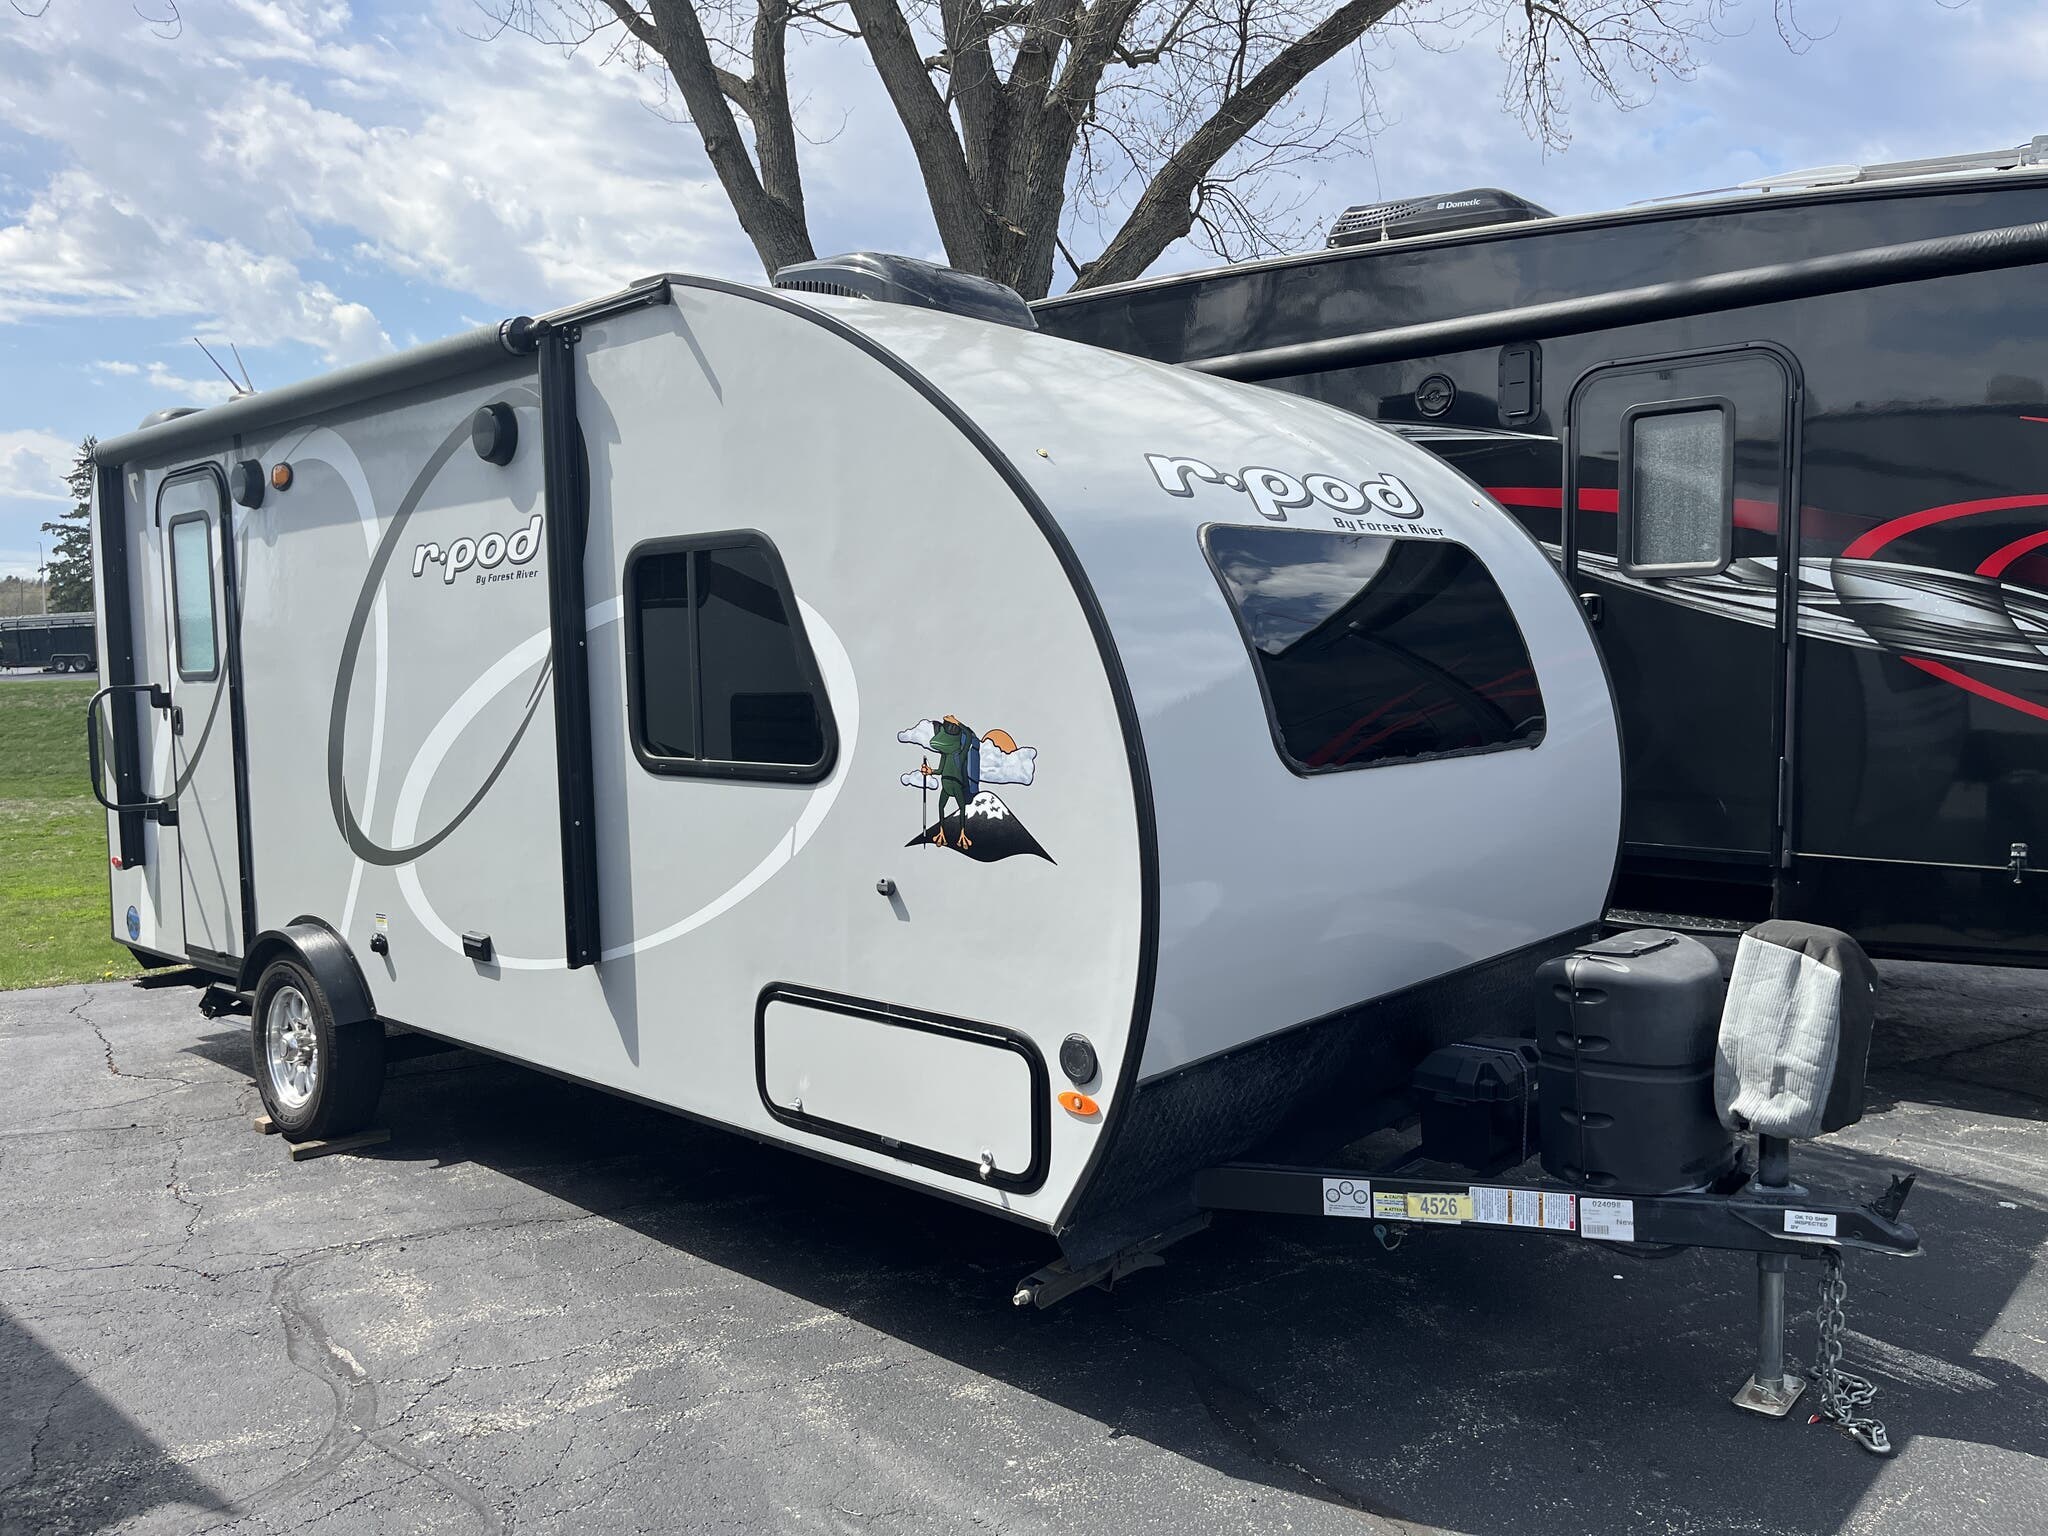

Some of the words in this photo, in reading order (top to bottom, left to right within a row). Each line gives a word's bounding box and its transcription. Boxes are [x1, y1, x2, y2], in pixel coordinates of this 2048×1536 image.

[1446, 198, 1480, 208] Dometic
[1333, 517, 1356, 532] By
[1357, 519, 1407, 534] Forest
[1409, 523, 1446, 537] River
[476, 575, 487, 585] By
[487, 572, 515, 583] Forest
[516, 569, 539, 580] River
[1420, 1197, 1458, 1216] 4526
